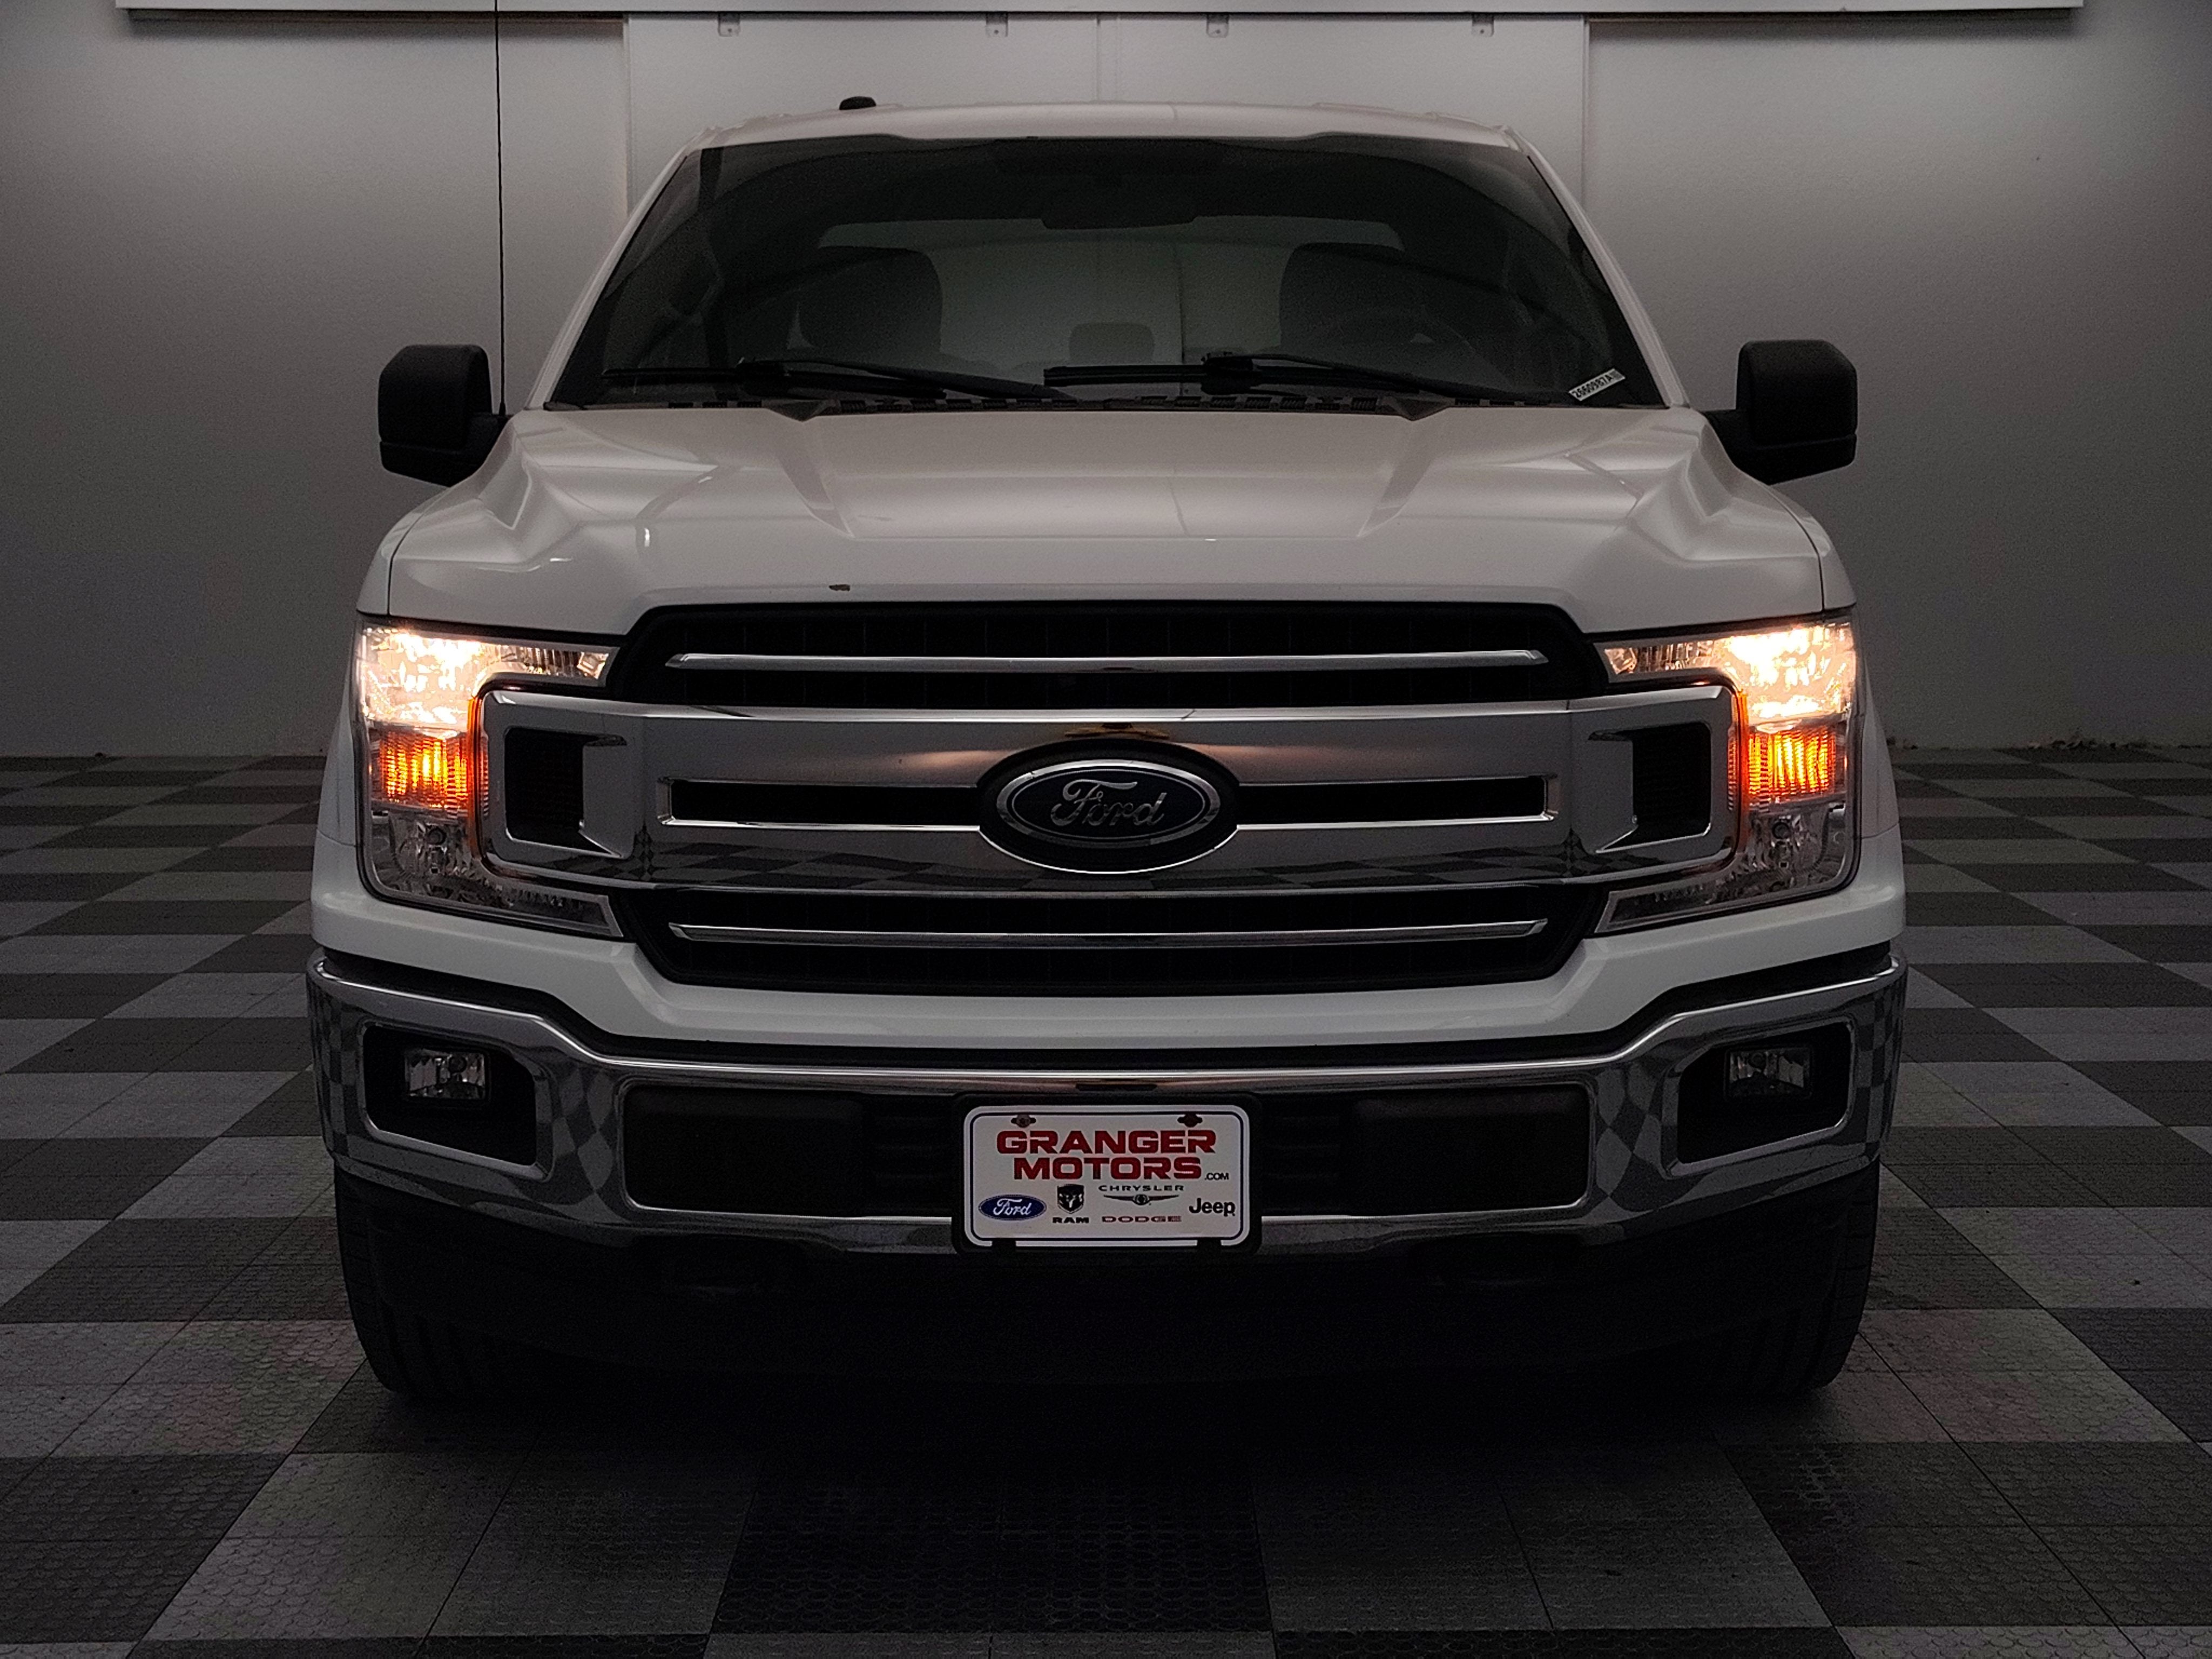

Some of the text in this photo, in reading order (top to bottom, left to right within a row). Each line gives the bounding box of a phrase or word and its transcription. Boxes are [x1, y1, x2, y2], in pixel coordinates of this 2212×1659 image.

[1050, 779, 1166, 826] Ford
[996, 1130, 1216, 1154] GRANGER
[1014, 1157, 1202, 1180] MOTORS
[993, 1198, 1032, 1216] Ford
[1189, 1197, 1235, 1217] Jeep
